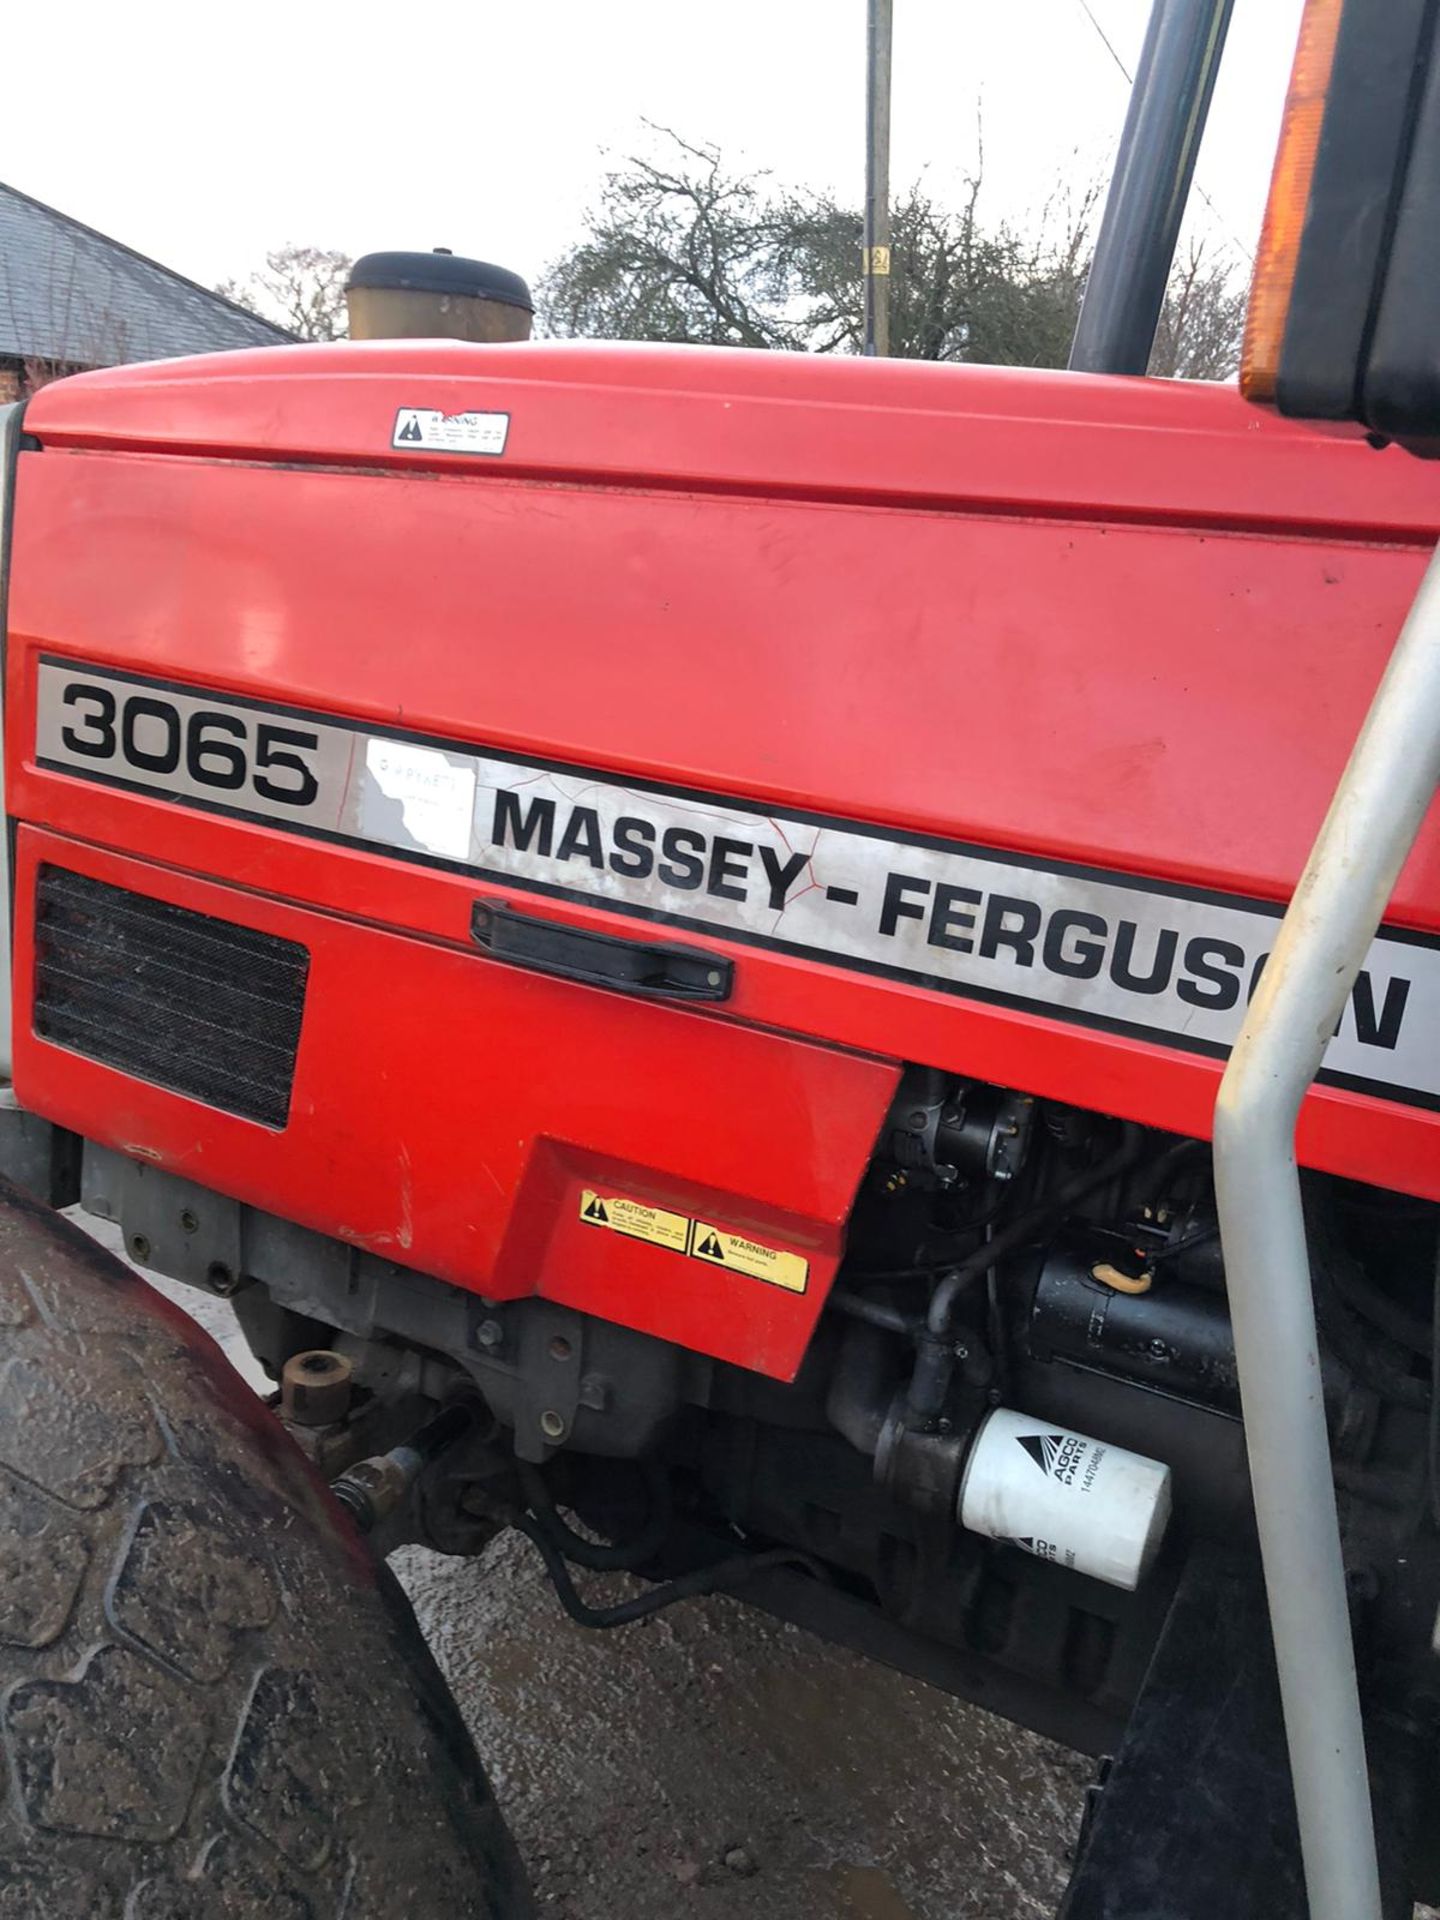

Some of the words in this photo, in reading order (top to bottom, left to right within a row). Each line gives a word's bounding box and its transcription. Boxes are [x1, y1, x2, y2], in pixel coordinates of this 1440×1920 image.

[62, 683, 319, 806] 3065
[491, 788, 811, 912] MASSEY
[878, 872, 1411, 1050] FERGUSN
[613, 1200, 656, 1220] CAUTION
[729, 1237, 777, 1260] WARNING
[1054, 1437, 1079, 1482] AGCO
[1065, 1441, 1088, 1486] PARTS
